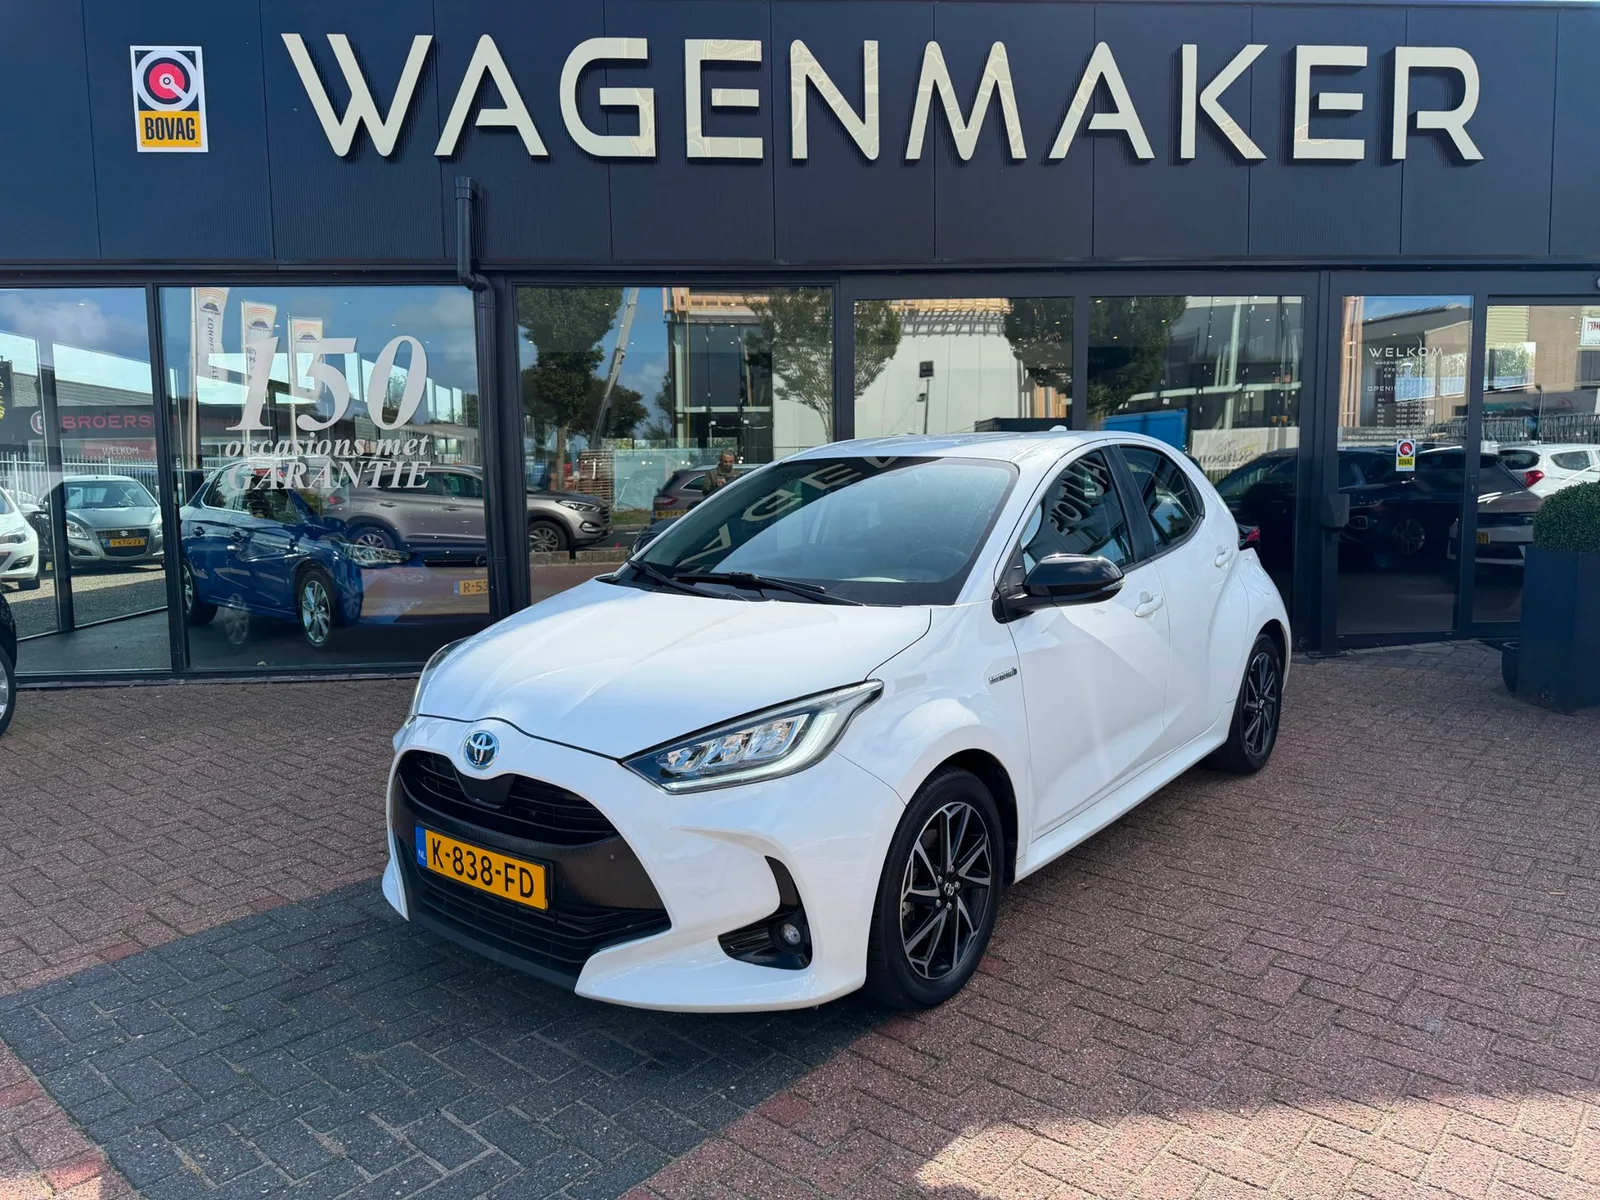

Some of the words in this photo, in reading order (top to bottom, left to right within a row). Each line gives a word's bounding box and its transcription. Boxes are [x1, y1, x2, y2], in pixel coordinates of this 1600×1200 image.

[280, 33, 1484, 162] WAGENMAKER
[144, 117, 196, 141] BOVAG
[1369, 347, 1443, 357] WELKOM
[225, 335, 428, 431] 150
[62, 415, 155, 429] BROERS
[102, 447, 139, 456] WELKOM
[225, 432, 366, 457] occasions
[376, 435, 430, 456] met
[227, 460, 431, 490] GARANTIE
[432, 837, 535, 899] K-838-FD
